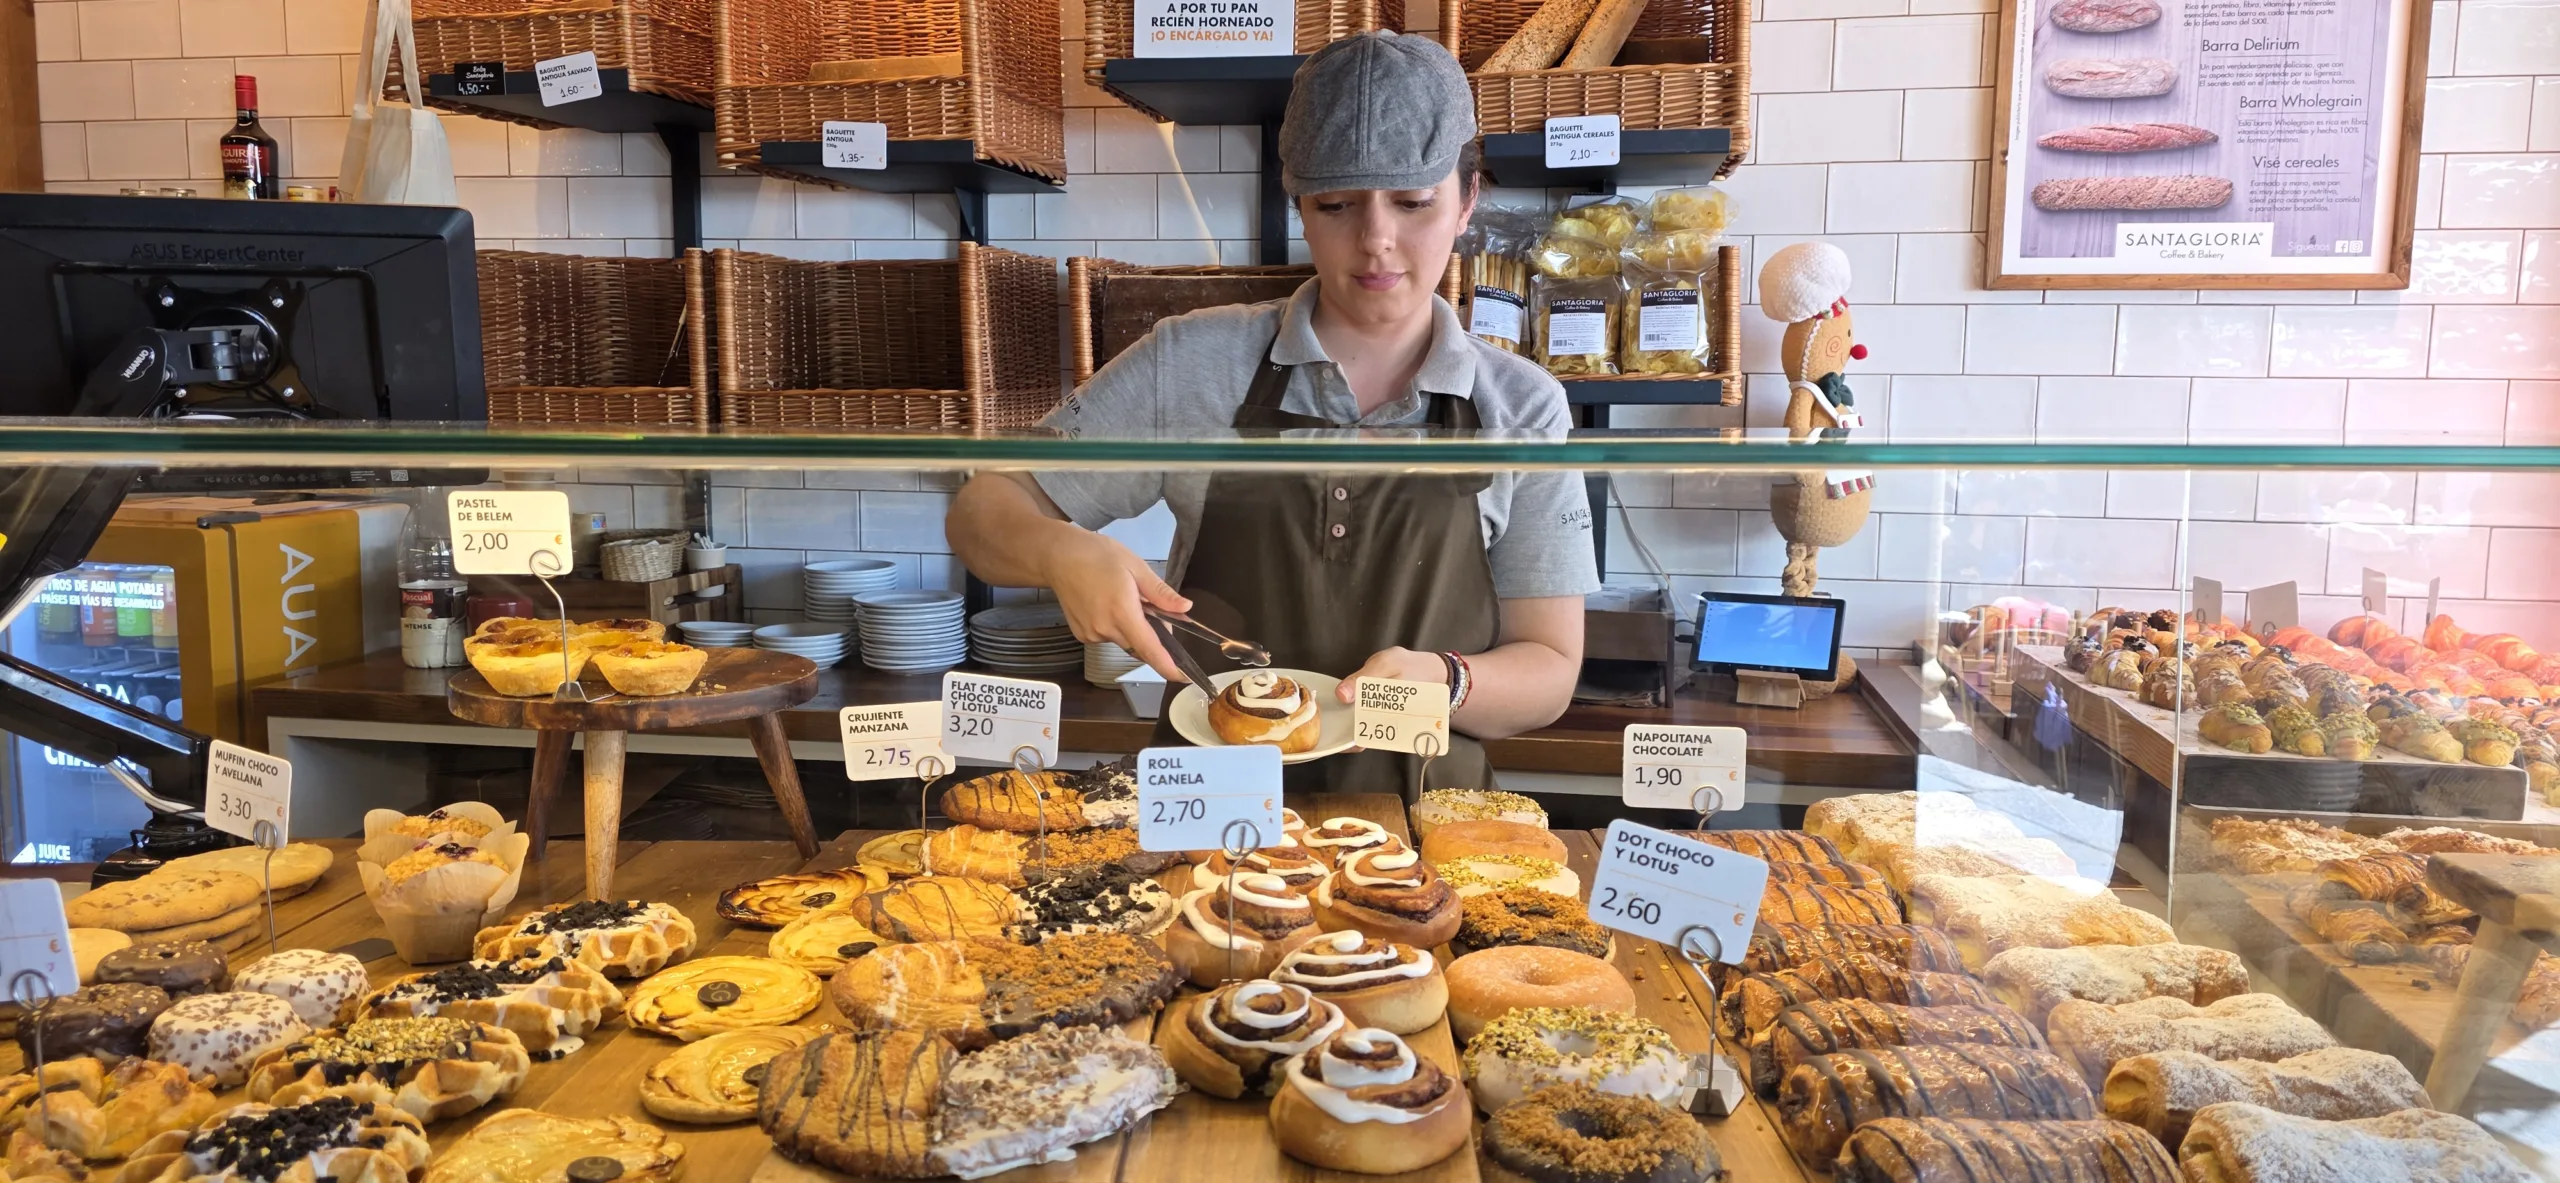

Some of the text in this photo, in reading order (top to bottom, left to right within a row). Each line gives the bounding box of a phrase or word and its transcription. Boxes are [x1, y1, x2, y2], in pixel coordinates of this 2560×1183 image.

[1167, 3, 1258, 13] A POR TU PAN
[1151, 14, 1274, 27] RECIÉN HORNEADO
[1151, 28, 1274, 43] ¡O ENCÁRGALO YA!
[2202, 36, 2300, 52] Barra Delirium
[539, 64, 567, 75] BAGUETTE
[541, 66, 593, 82] ANTIGUA SALVADO
[2239, 93, 2363, 111] Barra Wholegrain
[1583, 131, 1615, 139] CEREALES
[2252, 154, 2340, 169] Visé cereales
[2125, 232, 2261, 246] SANTAGLORIA
[131, 244, 305, 263] ASUS ExpertCenter
[2160, 250, 2225, 260] Coffee & Bakery
[1643, 290, 1698, 299] SANTAGLORIA
[122, 350, 150, 379] HUANUO
[457, 499, 498, 508] PASTEL
[458, 512, 513, 522] DE BELEM
[463, 532, 509, 554] 2,00
[74, 580, 88, 592] DE
[91, 580, 117, 594] AGUA
[119, 582, 164, 596] POTABLE
[69, 596, 81, 606] EN
[102, 597, 113, 607] DE
[280, 543, 319, 678] AUA
[951, 681, 1047, 700] FLAT CROISSANT
[1361, 682, 1418, 696] DOT CHOCO
[950, 690, 1046, 710] CHOCO BLANCO
[1361, 691, 1409, 703] BLANCO Y
[950, 700, 998, 715] Y LOTUS
[1361, 700, 1405, 712] FILIPINOS
[847, 711, 904, 723] CRUJIENTE
[849, 722, 909, 734] MANZANA
[949, 715, 994, 738] 3,20
[1358, 721, 1396, 741] 2,60
[1633, 732, 1713, 744] NAPOLITANA
[864, 748, 912, 766] 2,75
[1632, 745, 1704, 757] CHOCOLATE
[215, 749, 279, 777] MUFFIN CHOCO
[1148, 758, 1183, 770] ROLL
[214, 764, 263, 788] Y AVELLANA
[1148, 773, 1205, 786] CANELA
[1635, 766, 1683, 788] 1,90
[219, 792, 252, 820] 3,30
[1152, 798, 1206, 827] 2,70
[38, 844, 71, 861] JUICE
[1617, 830, 1715, 868] DOT CHOCO
[1614, 846, 1680, 876] Y LOTUS
[1600, 886, 1662, 926] 2,60
